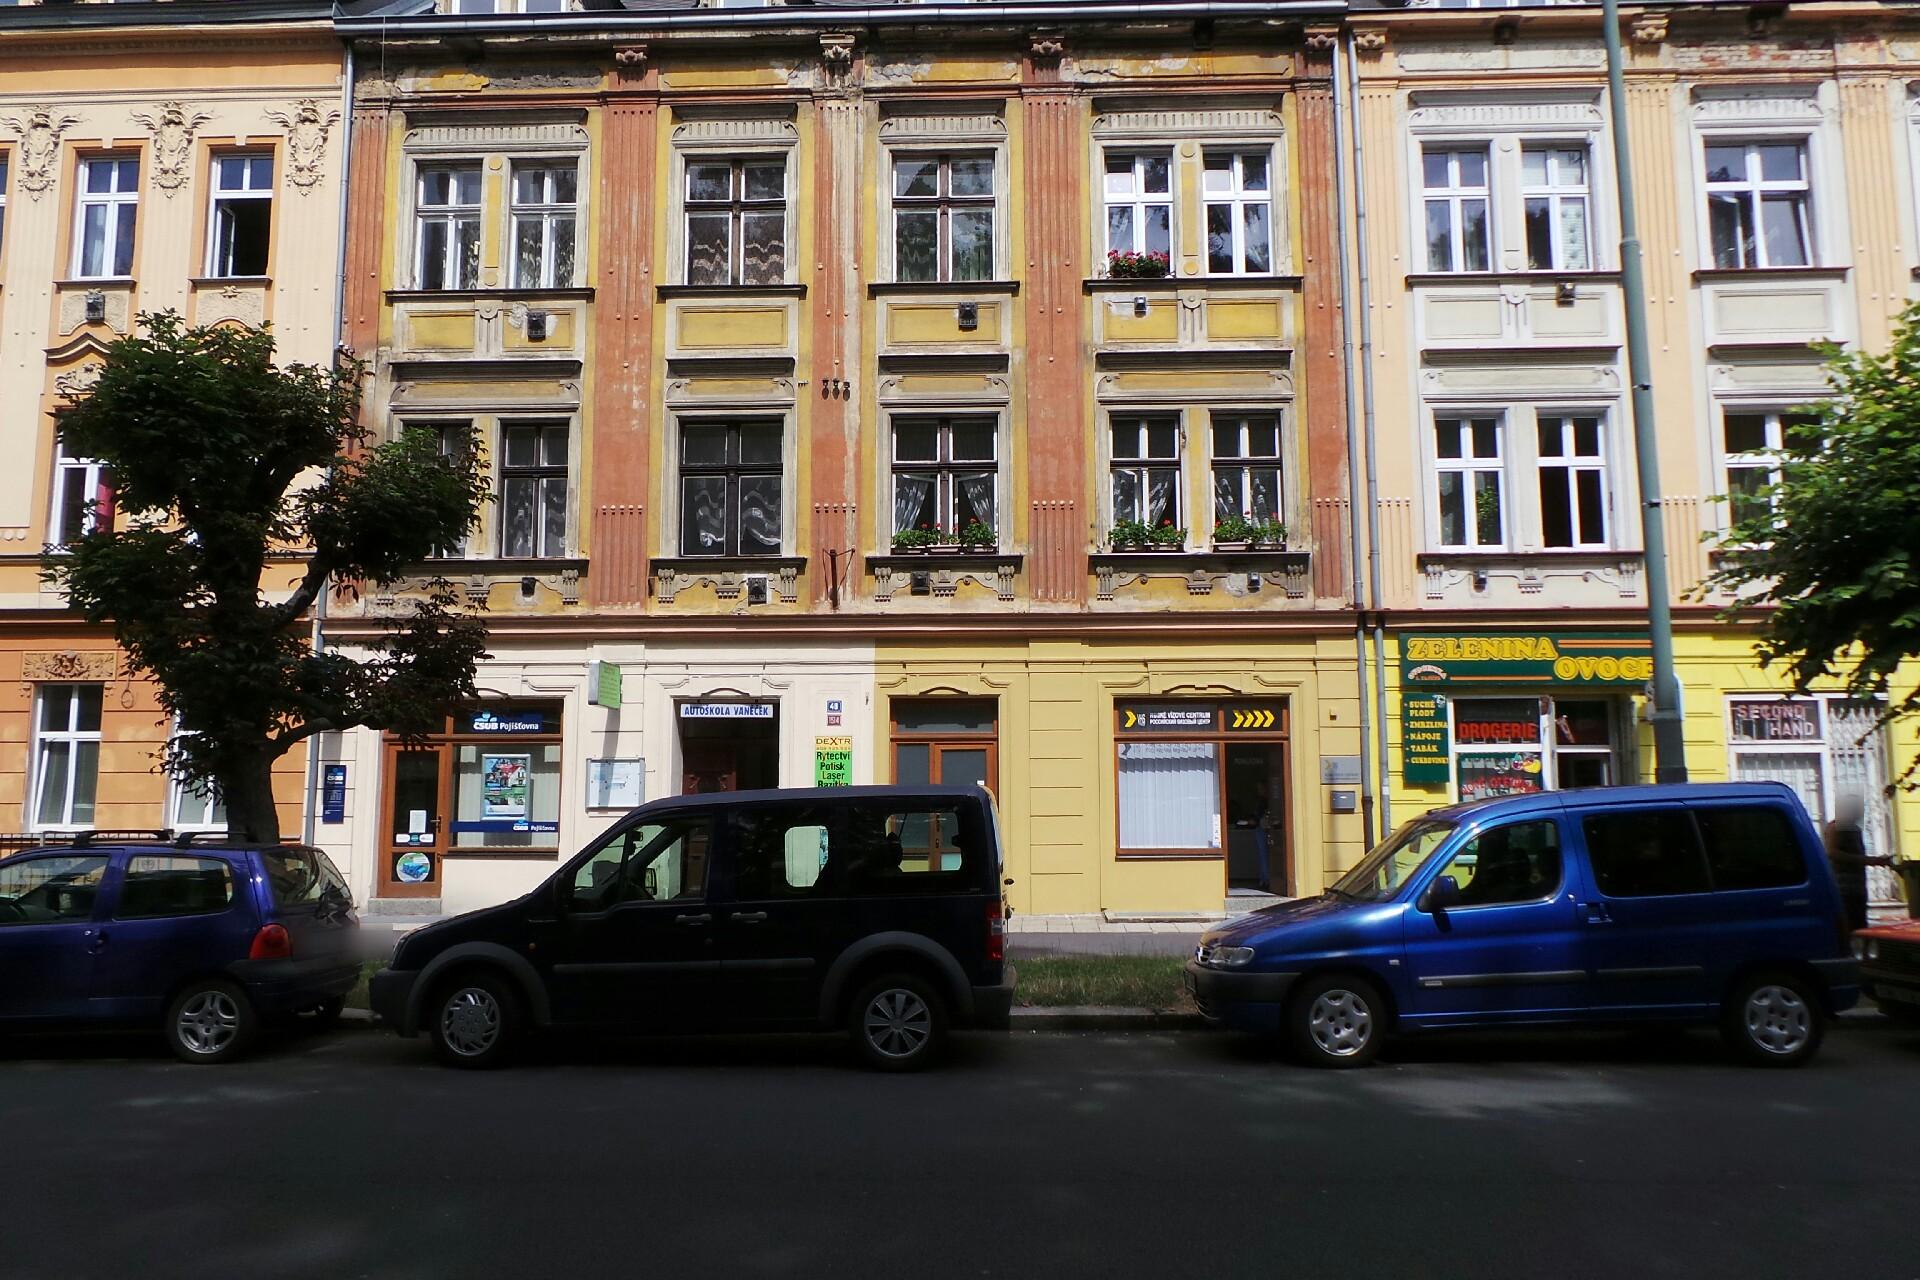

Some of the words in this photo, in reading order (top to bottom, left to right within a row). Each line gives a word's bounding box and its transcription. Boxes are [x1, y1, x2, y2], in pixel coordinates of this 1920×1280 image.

[1407, 637, 1559, 661] ZELENINA
[1554, 656, 1653, 681] OVOCE
[684, 704, 731, 716] AUTOŠKOLA
[733, 704, 769, 716] VANĚČEK
[1409, 709, 1435, 717] PLODY
[1737, 704, 1805, 719] SECOND
[499, 721, 539, 732] Pojišťovna
[1459, 722, 1538, 739] DROGERIE
[1769, 721, 1815, 736] HAND
[816, 737, 851, 746] DEXTR
[820, 761, 845, 771] Potisk
[822, 771, 845, 780] Laser
